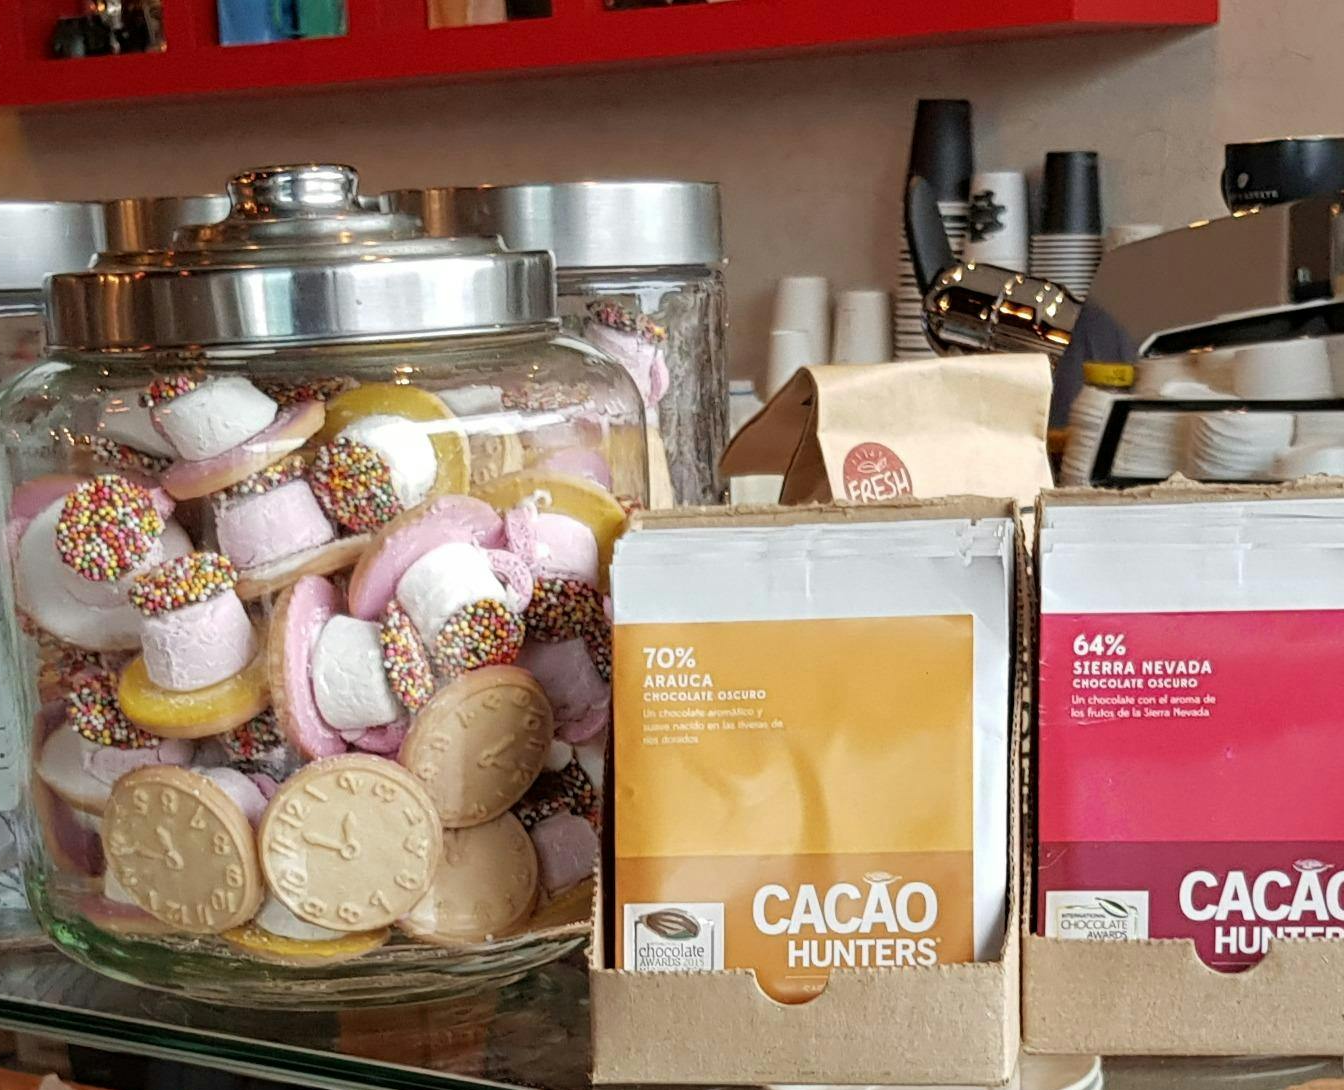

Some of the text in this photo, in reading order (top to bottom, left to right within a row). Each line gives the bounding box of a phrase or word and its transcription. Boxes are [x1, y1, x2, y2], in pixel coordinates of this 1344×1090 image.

[848, 468, 911, 502] FRESH
[1073, 634, 1126, 656] 64%
[642, 647, 696, 669] 70%
[1073, 660, 1212, 675] SIERRA NEVADA
[643, 674, 713, 688] ARAUCA
[1073, 678, 1198, 689] CHOCOLATE OSCURO
[643, 690, 767, 701] CHOCOLATE OSCURO
[1072, 694, 1216, 705] Un chocolate con el aroma de
[659, 708, 704, 718] chocolate
[1071, 707, 1209, 717] los frutos de la Sierra Nevada
[1061, 919, 1128, 930] CHOCOLATE
[1087, 930, 1128, 940] AWARDS
[638, 943, 705, 960] chocolate
[788, 937, 938, 968] HUNTERS
[640, 957, 681, 967] AWARDS
